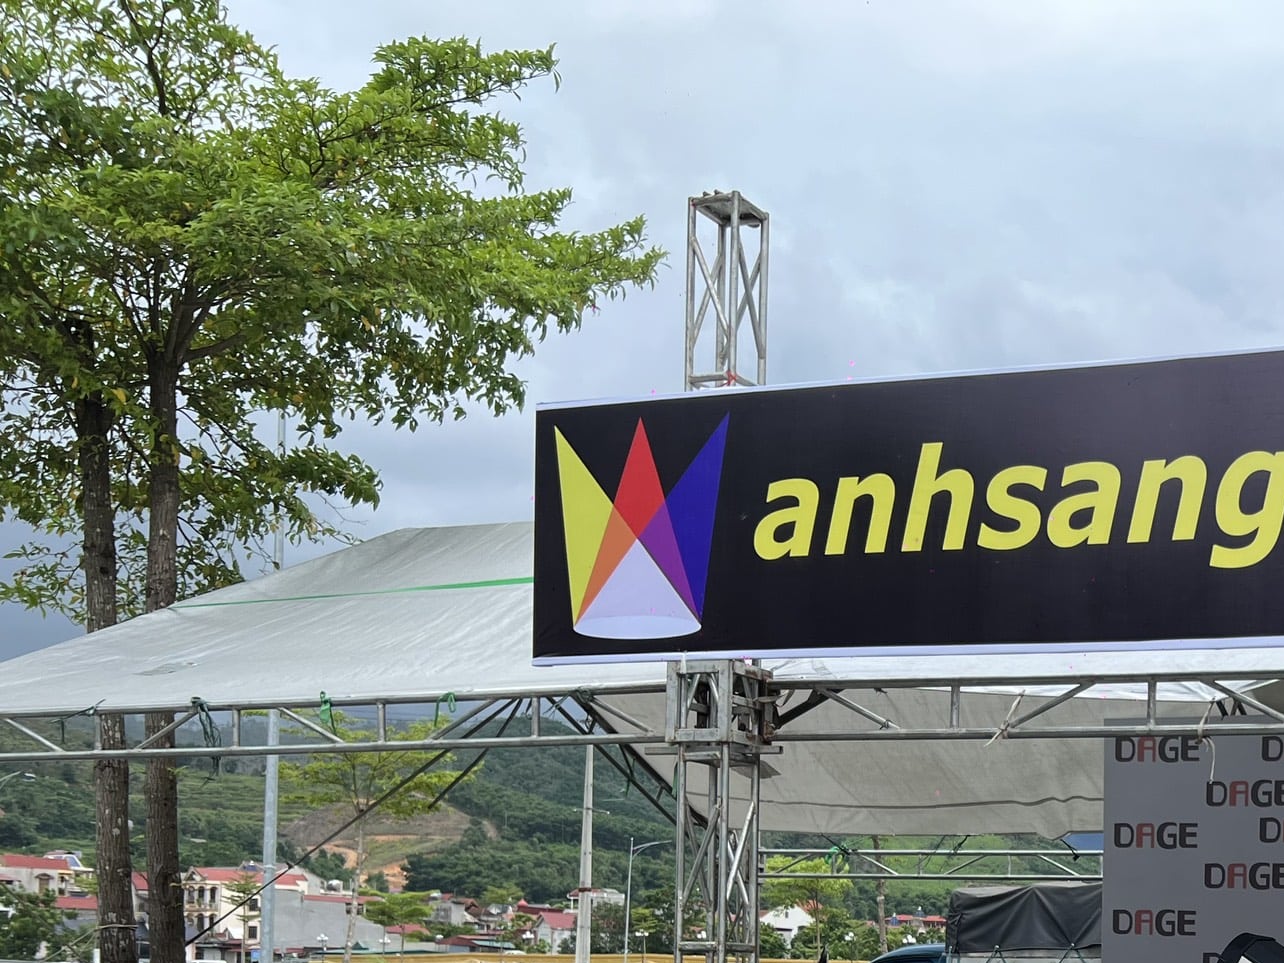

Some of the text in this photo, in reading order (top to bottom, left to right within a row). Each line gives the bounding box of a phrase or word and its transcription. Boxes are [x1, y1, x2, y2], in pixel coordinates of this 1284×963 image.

[1114, 735, 1200, 763] DAGE
[1113, 822, 1198, 850] DAGE
[1112, 909, 1197, 937] DAGE
